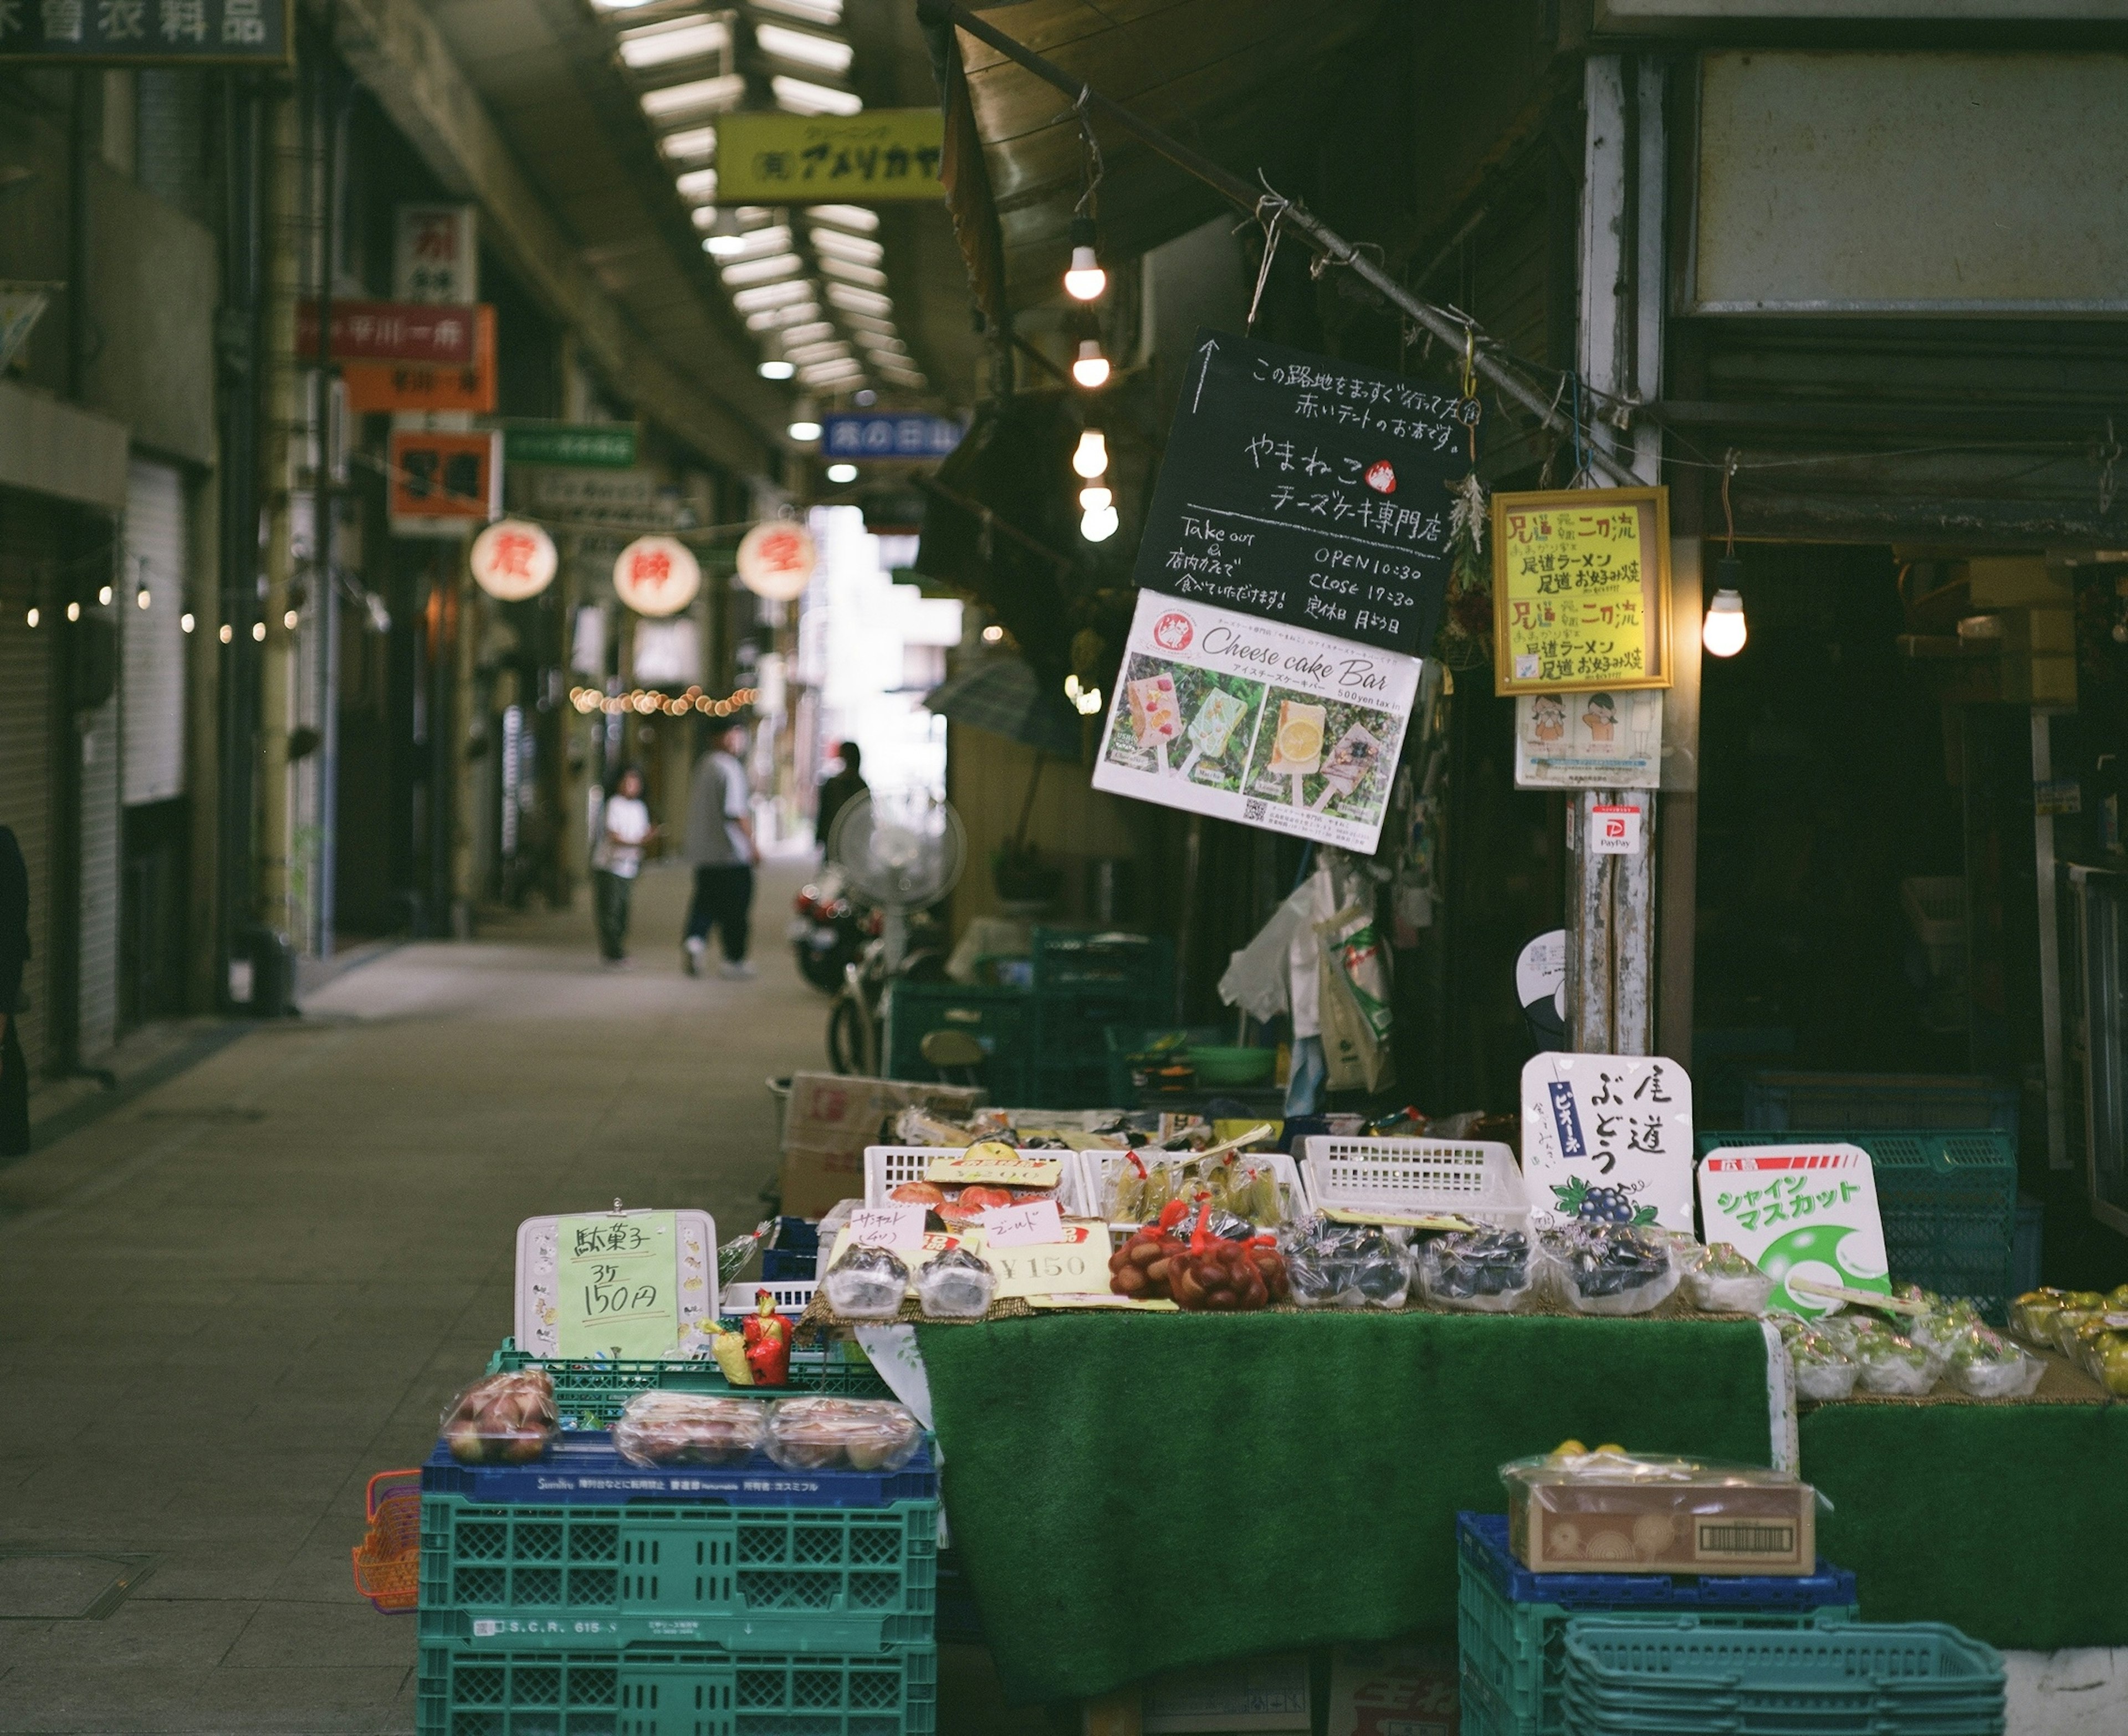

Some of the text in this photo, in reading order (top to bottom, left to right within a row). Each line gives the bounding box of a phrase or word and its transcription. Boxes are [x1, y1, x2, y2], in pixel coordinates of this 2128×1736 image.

[1245, 433, 1362, 485] やまねこ
[1270, 484, 1442, 542] チーズケーキ専門店
[1180, 515, 1256, 547] Take out
[1314, 548, 1421, 581] OPEN 10:30
[1520, 553, 1613, 576] 尾道ラーメン
[1309, 572, 1414, 607] CLOSE 17:30
[1303, 594, 1400, 635] 定休日 月よう日
[1201, 626, 1389, 691] Cheese cake Bar
[1526, 640, 1615, 661] 尾道ラーメン
[1232, 663, 1326, 691] アイスチーズケーキバー
[1337, 688, 1374, 708] 500yen
[1600, 839, 1630, 849] PayPay
[1555, 1092, 1581, 1154] ピオーネ
[1591, 1073, 1624, 1175] ぶどう
[1628, 1064, 1672, 1154] 尾道
[1717, 1175, 1808, 1215] シャイン
[1736, 1180, 1861, 1232] マスカット
[574, 1222, 651, 1257] 駄菓子
[1001, 1255, 1086, 1280] ¥150
[585, 1284, 657, 1315] 150円
[509, 1621, 565, 1633] S.C.R.
